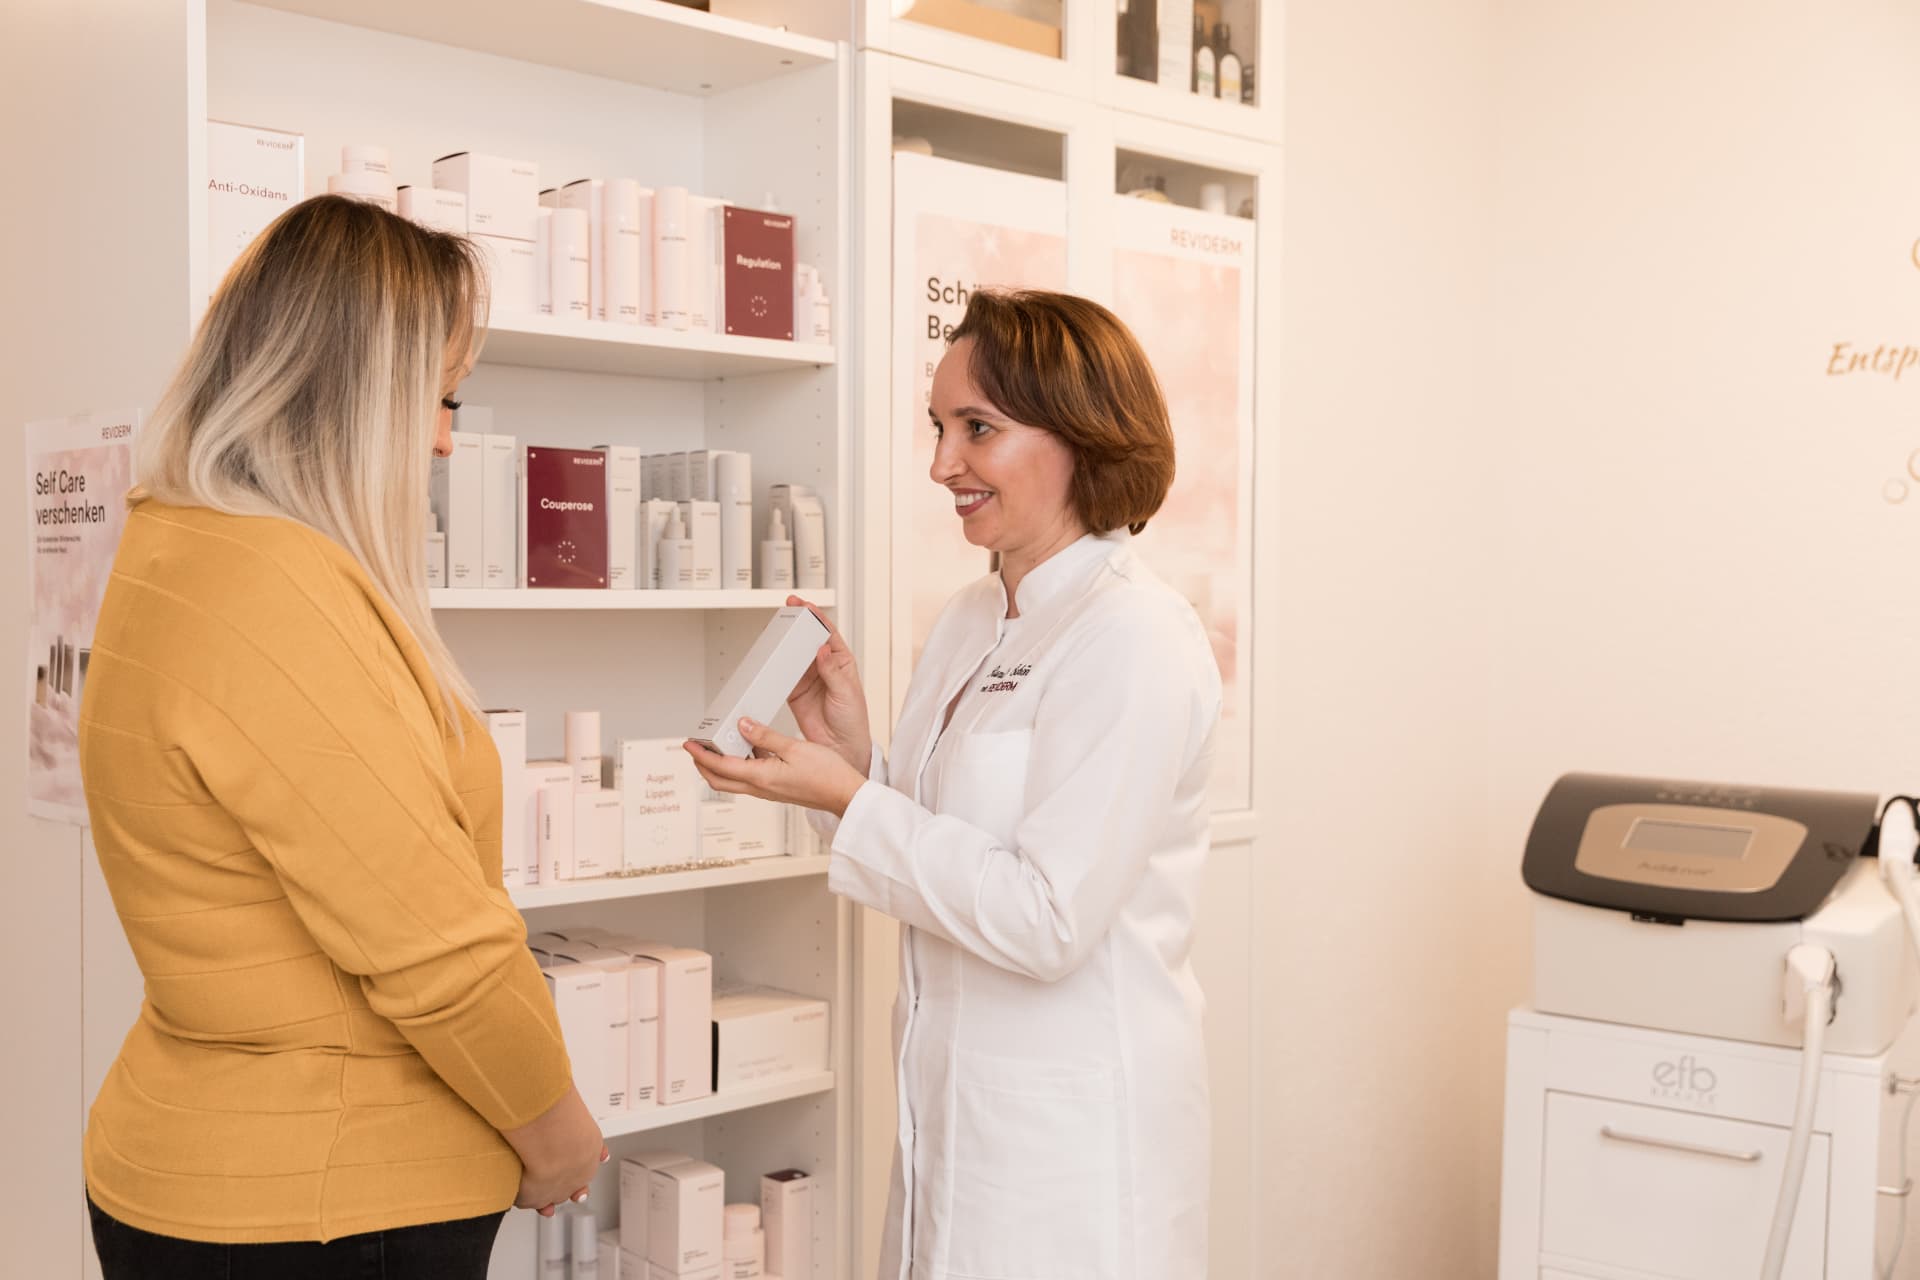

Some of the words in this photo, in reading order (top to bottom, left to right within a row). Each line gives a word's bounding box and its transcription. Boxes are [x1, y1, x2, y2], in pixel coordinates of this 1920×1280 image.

[208, 178, 288, 201] Anti-Oxidans
[736, 253, 782, 270] Regulation
[927, 277, 982, 305] Sch
[1826, 341, 1920, 381] Entsp
[35, 471, 56, 495] Self
[59, 469, 86, 494] Care
[36, 500, 106, 525] verschenken
[540, 498, 594, 512] Couperose
